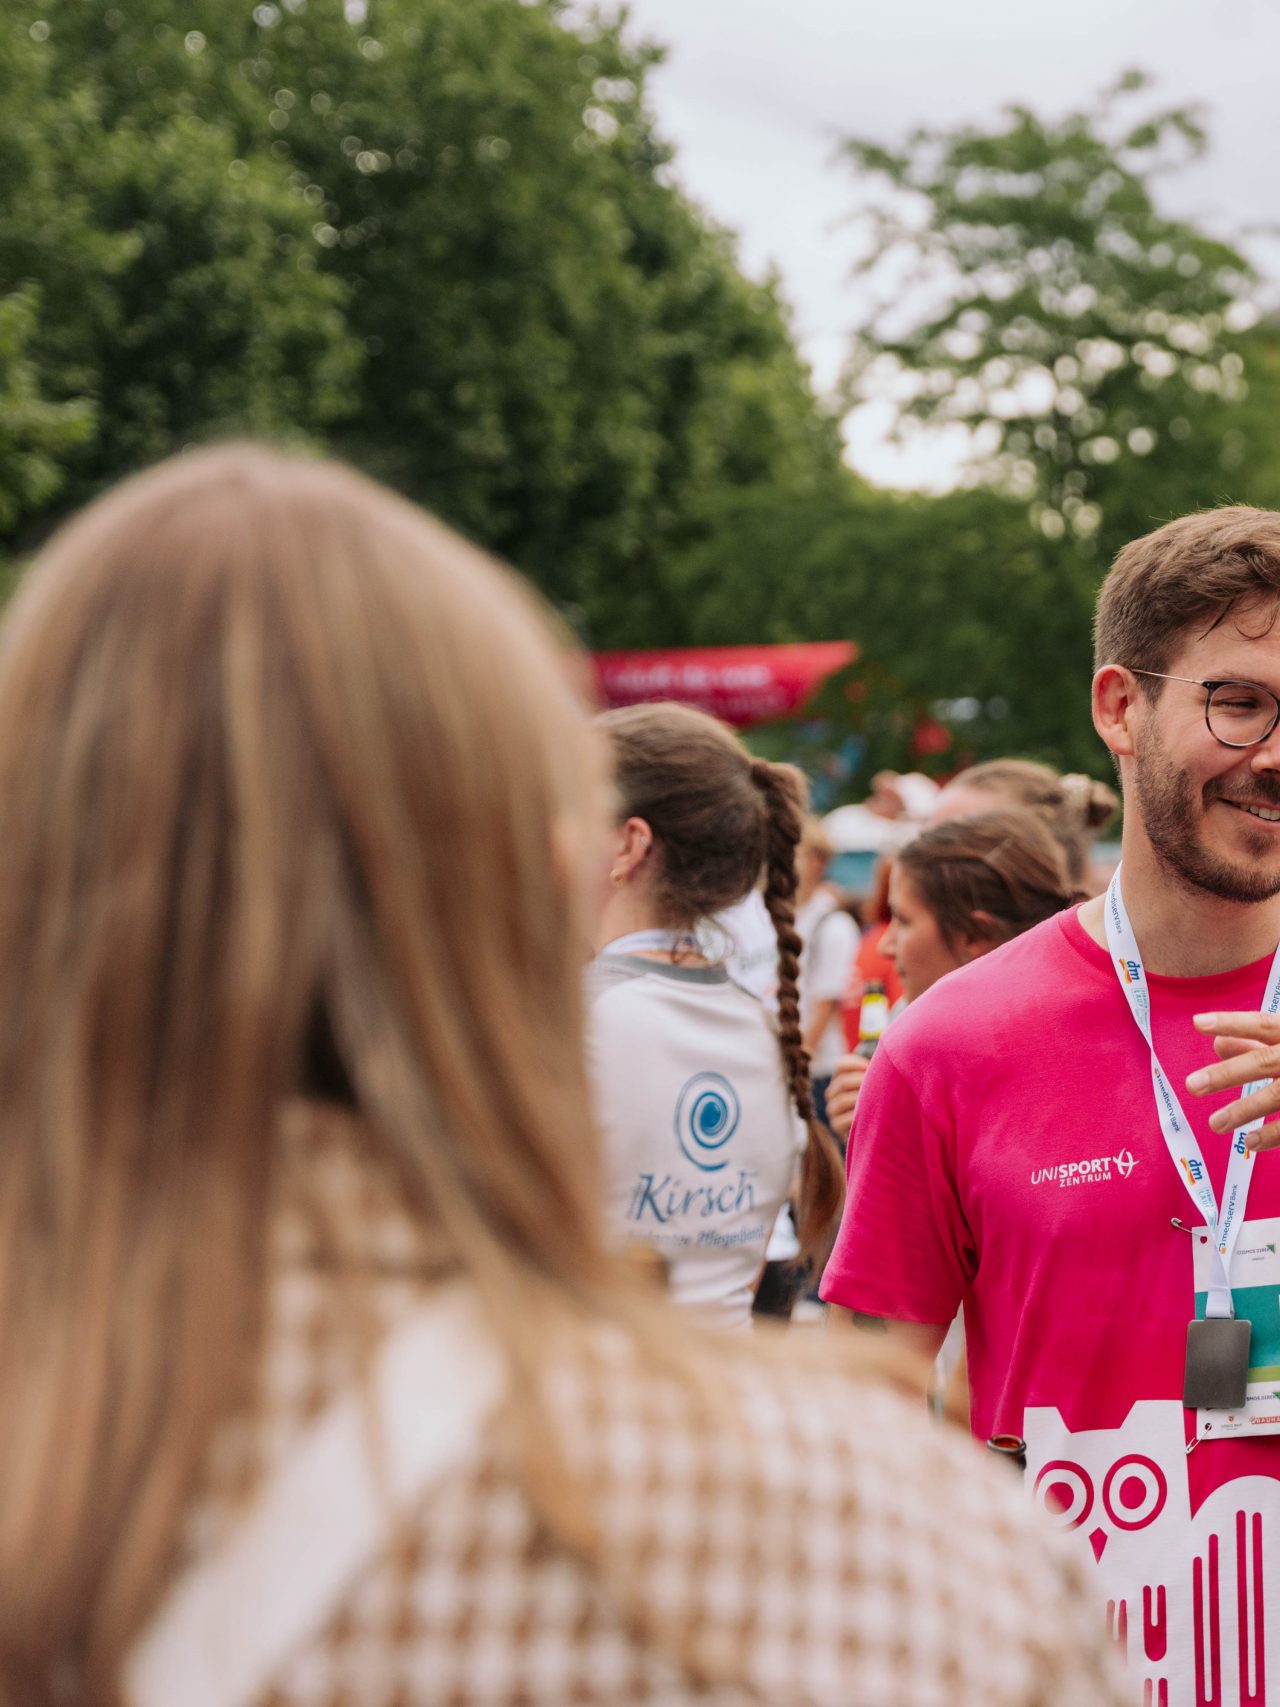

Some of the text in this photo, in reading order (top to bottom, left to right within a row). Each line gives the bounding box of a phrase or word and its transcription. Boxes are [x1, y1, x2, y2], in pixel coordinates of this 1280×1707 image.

[1126, 960, 1141, 981] dm
[1157, 1077, 1181, 1133] mediserv Bank
[1059, 1172, 1111, 1188] ZENTRUM
[1189, 1159, 1203, 1181] dm
[627, 1170, 757, 1223] Kirsch
[1221, 1184, 1238, 1242] mediserv Bank
